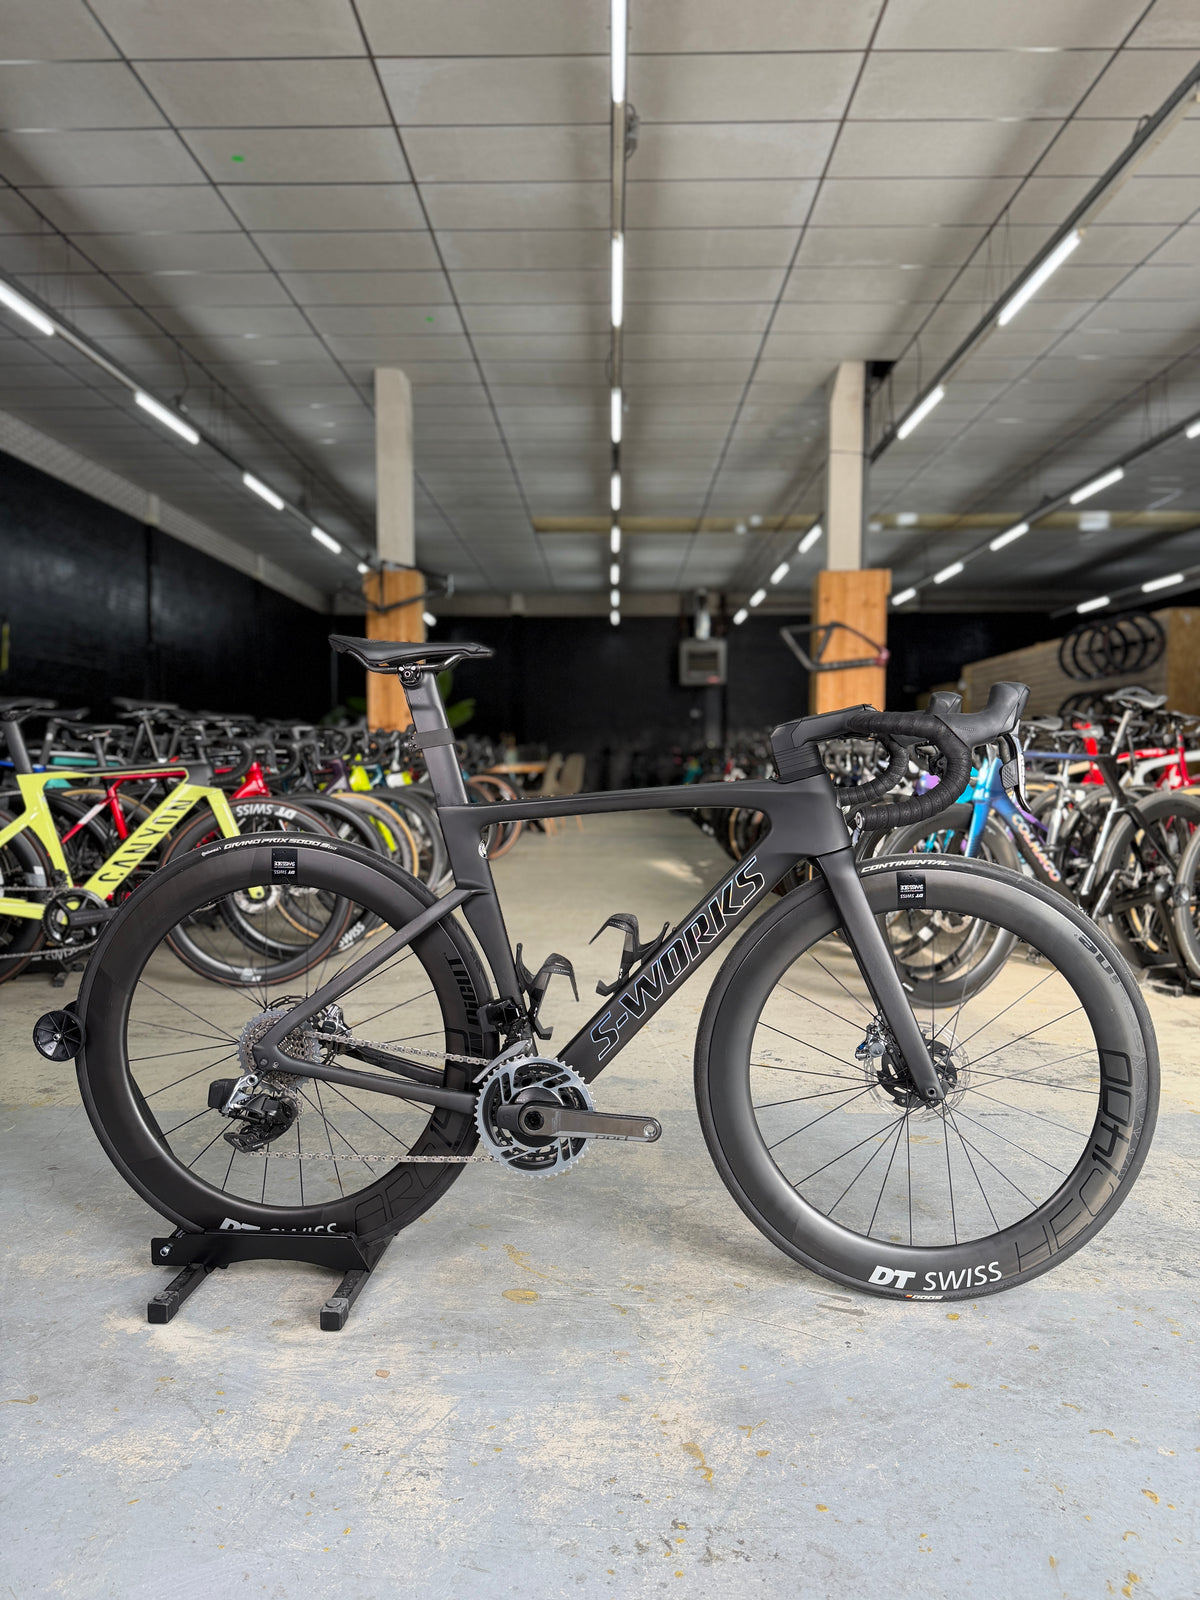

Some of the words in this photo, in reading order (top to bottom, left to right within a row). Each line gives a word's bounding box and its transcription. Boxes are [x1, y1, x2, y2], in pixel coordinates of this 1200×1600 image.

[236, 804, 274, 817] SWISS
[275, 806, 298, 820] DT
[97, 798, 193, 883] CANYON
[1011, 813, 1061, 883] COLNAGO
[861, 859, 950, 874] CONTINENTAL
[589, 855, 765, 1062] S-WORKS
[868, 1265, 917, 1289] DT
[923, 1261, 1003, 1292] SWISS
